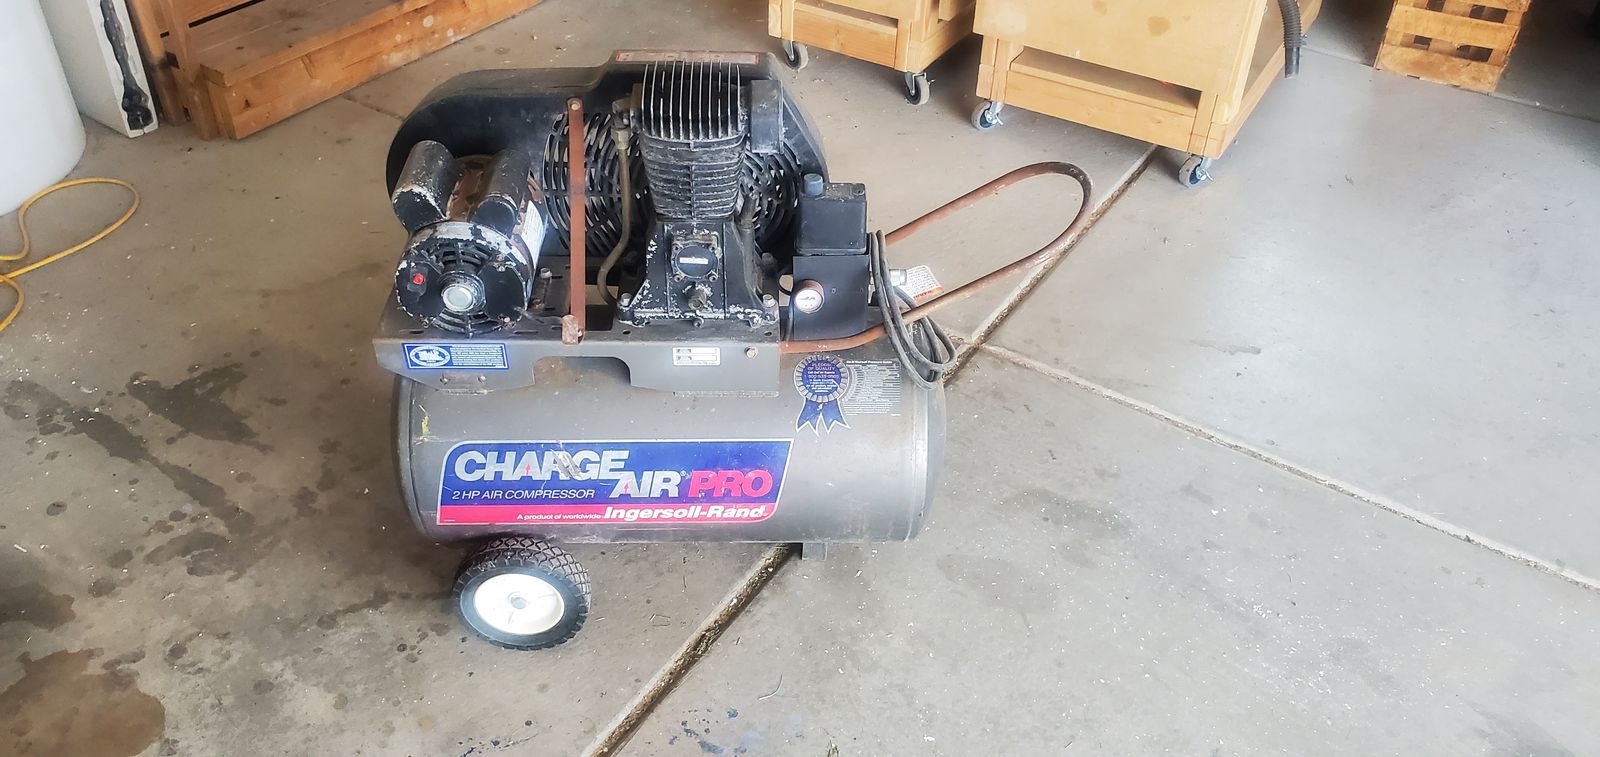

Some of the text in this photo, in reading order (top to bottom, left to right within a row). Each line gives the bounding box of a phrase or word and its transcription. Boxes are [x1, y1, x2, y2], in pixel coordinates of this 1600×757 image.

[454, 450, 629, 482] CHARGE
[452, 489, 595, 500] 2 HP AIR COMPRESSOR
[688, 469, 773, 498] PRO
[524, 513, 553, 521] product
[604, 505, 765, 522] Ingersoll-Rand
